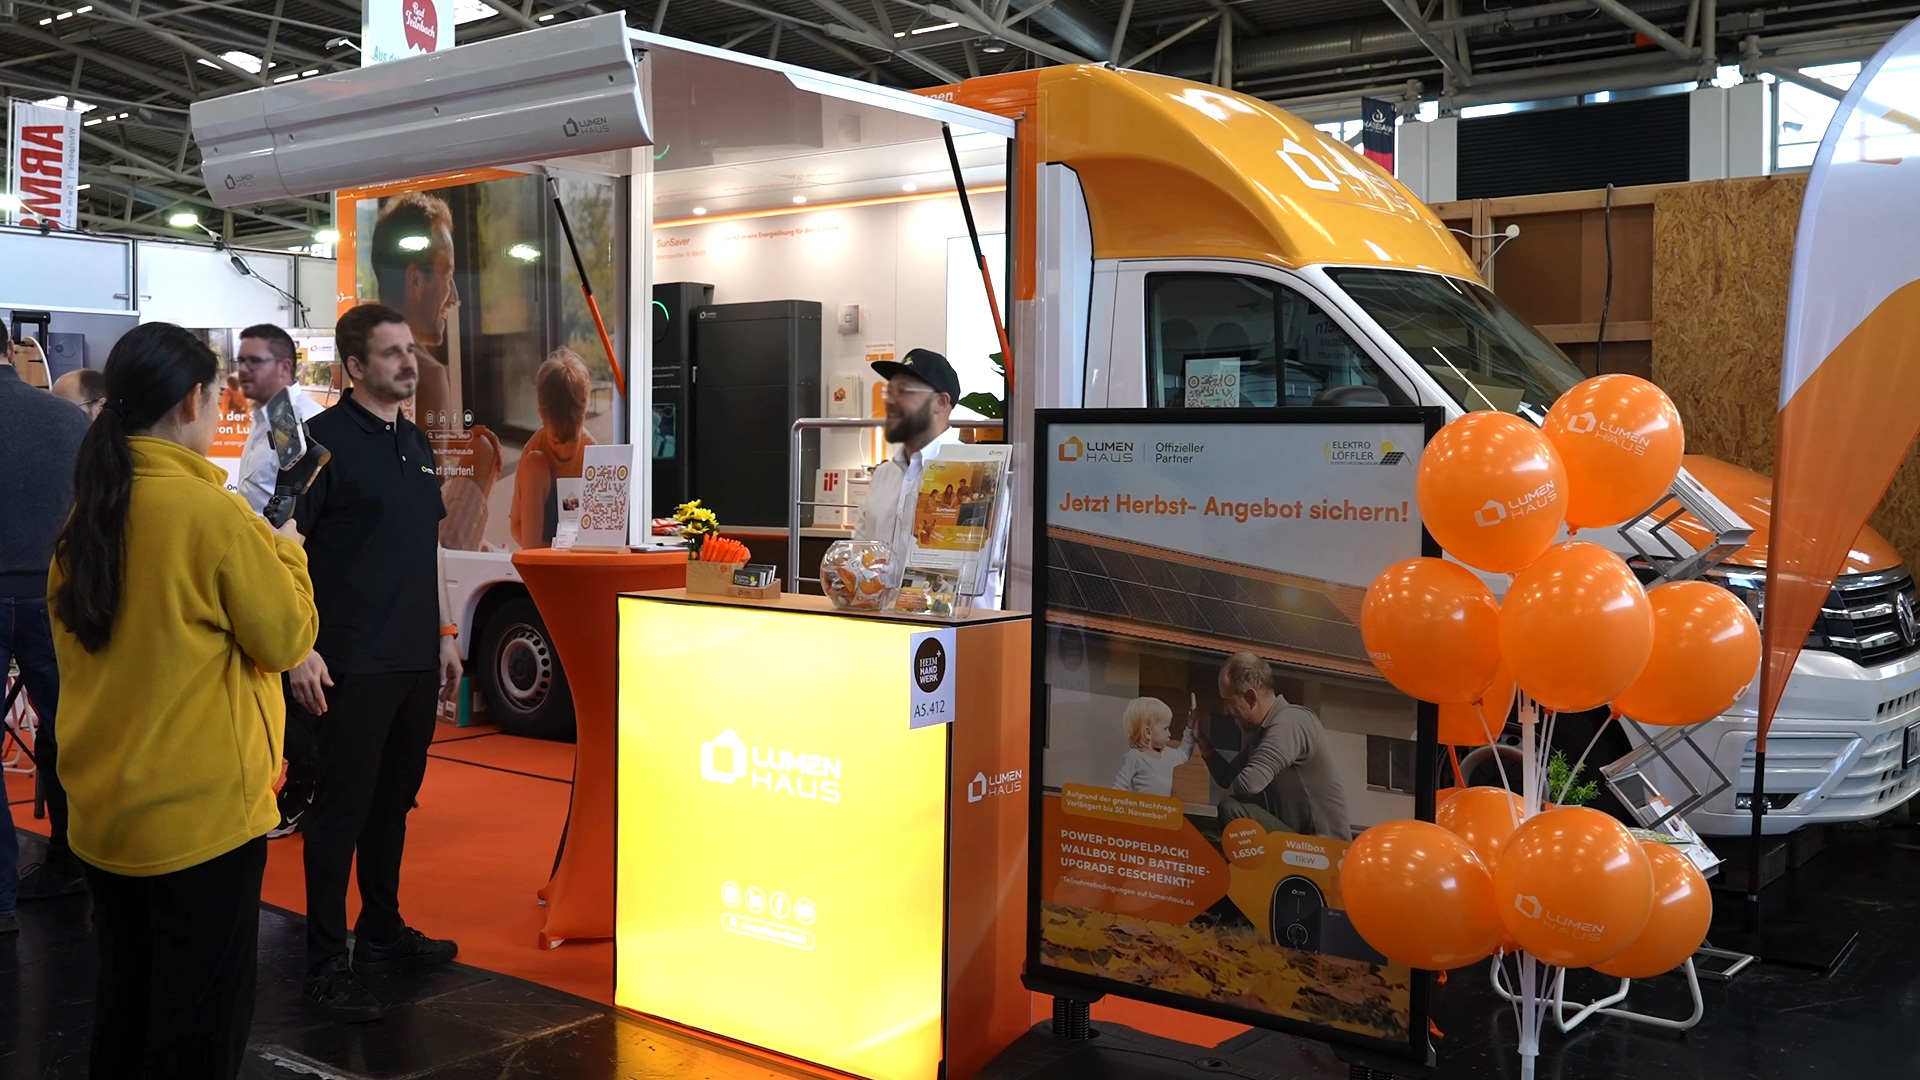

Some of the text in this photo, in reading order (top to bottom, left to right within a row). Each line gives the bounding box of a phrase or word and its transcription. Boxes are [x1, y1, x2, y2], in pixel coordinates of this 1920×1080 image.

[412, 1, 426, 18] Bad
[405, 10, 436, 38] Feilnbach
[578, 117, 608, 128] LUMEN
[580, 124, 610, 135] HAUS
[235, 174, 254, 182] LUMEN
[656, 238, 690, 248] SunSaver
[1600, 420, 1650, 448] LUMEN
[1086, 442, 1134, 452] LUMEN
[1156, 442, 1204, 453] Offizieller
[1332, 441, 1371, 450] ELEKTRO
[1595, 430, 1646, 457] HAUS
[1086, 452, 1134, 462] HAUS
[1156, 454, 1194, 463] Partner
[1332, 450, 1374, 460] LÖFFLER
[444, 465, 474, 476] starten!
[1508, 480, 1554, 509] LUMEN
[1059, 492, 1408, 524] Jetzt Herbst- Angebot sichern!
[1510, 490, 1557, 520] HAUS
[920, 666, 938, 676] HAND
[920, 674, 938, 684] WERK
[914, 700, 945, 718] A5.412
[752, 745, 841, 779] LUMEN
[752, 768, 840, 802] HAUS
[988, 769, 1022, 786] LUMEN
[988, 780, 1022, 798] HAUS
[1066, 790, 1179, 814] Aufgrund der großen Nachfrage:
[1066, 799, 1167, 820] Verlängert bis 30. November!
[1240, 828, 1257, 838] Wert
[1060, 830, 1189, 858] POWER-DOPPELPACK!
[1238, 838, 1252, 846] von
[1286, 840, 1326, 853] Wallbox
[1060, 843, 1210, 876] WALLBOX UND BATTERIE-
[1232, 846, 1265, 859] 1.650€
[1294, 855, 1316, 865] 11kW
[1060, 857, 1115, 875] UPGRADE
[1137, 890, 1148, 898] auf
[1149, 892, 1194, 906] lumenhaus.de
[1546, 910, 1605, 933] LUMEN
[1543, 919, 1600, 942] HAUS
